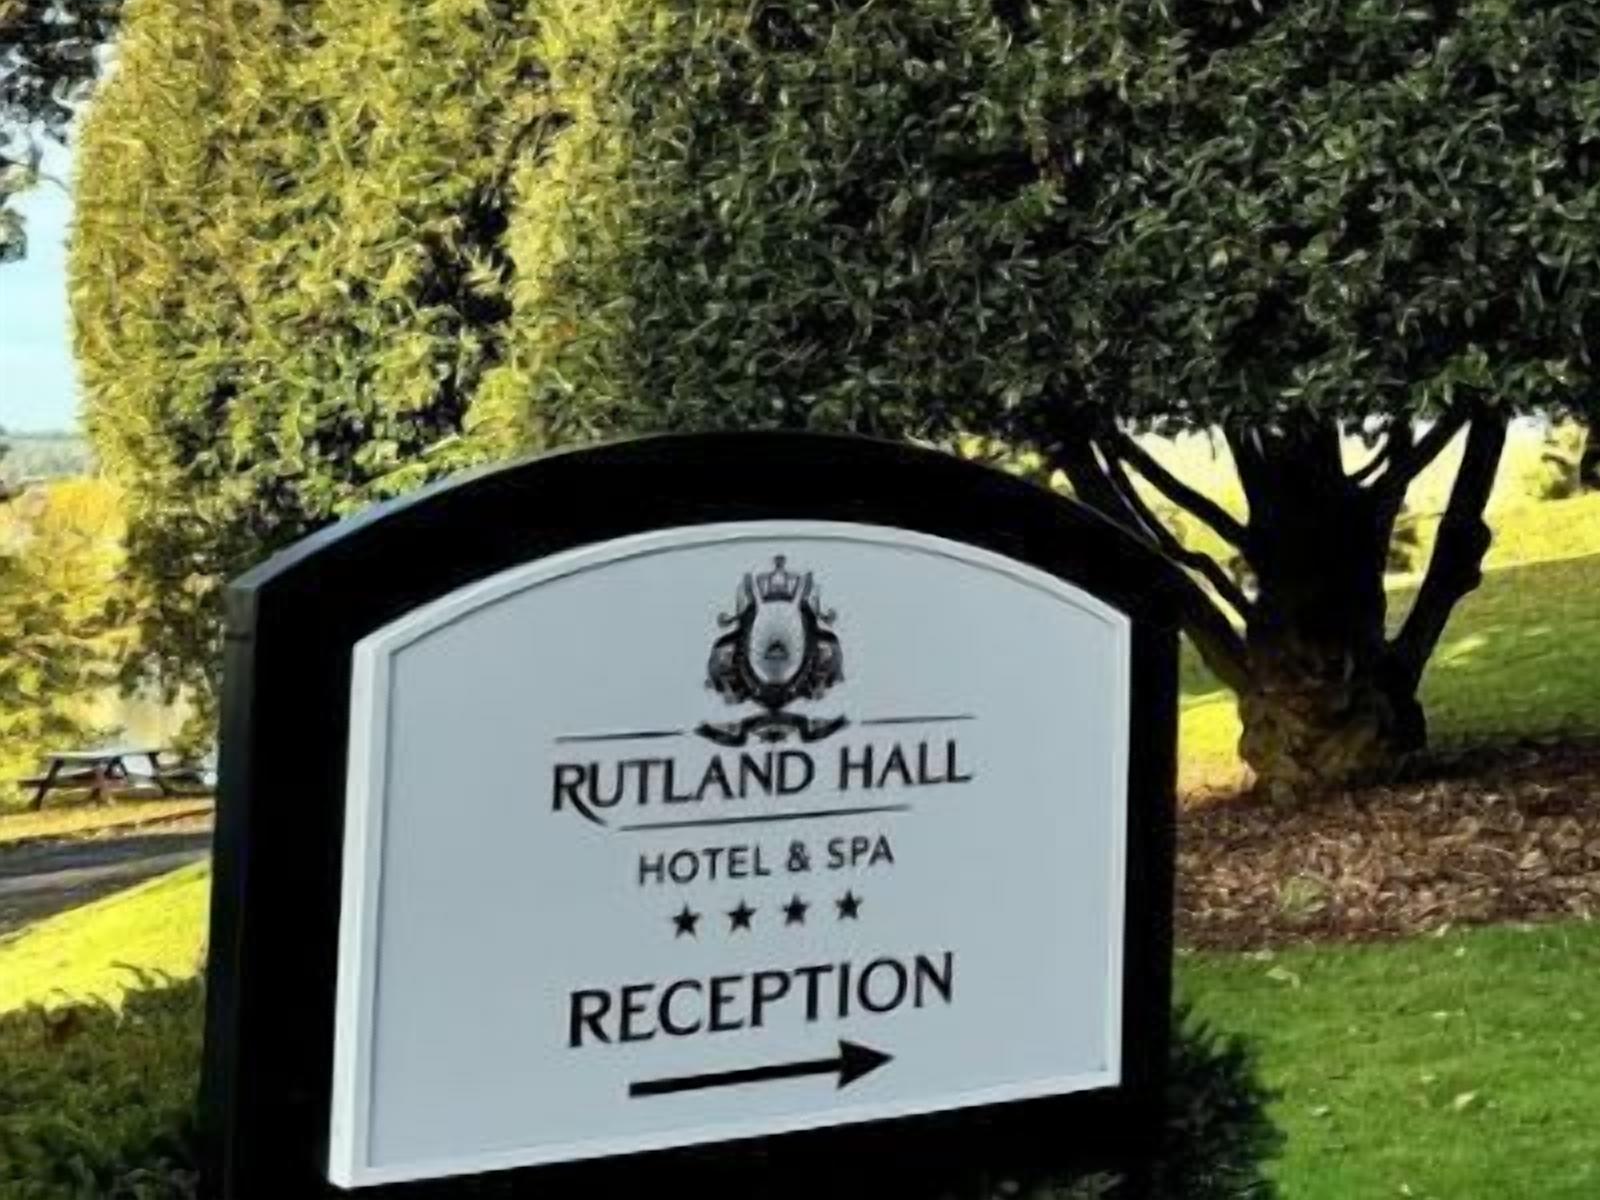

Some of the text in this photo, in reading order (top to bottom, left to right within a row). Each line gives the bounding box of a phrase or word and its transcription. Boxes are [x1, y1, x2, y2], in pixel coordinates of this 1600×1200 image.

[551, 739, 974, 827] RUTLAND HALL
[638, 835, 895, 886] HOTEL & SPA
[569, 951, 953, 1049] RECEPTION
